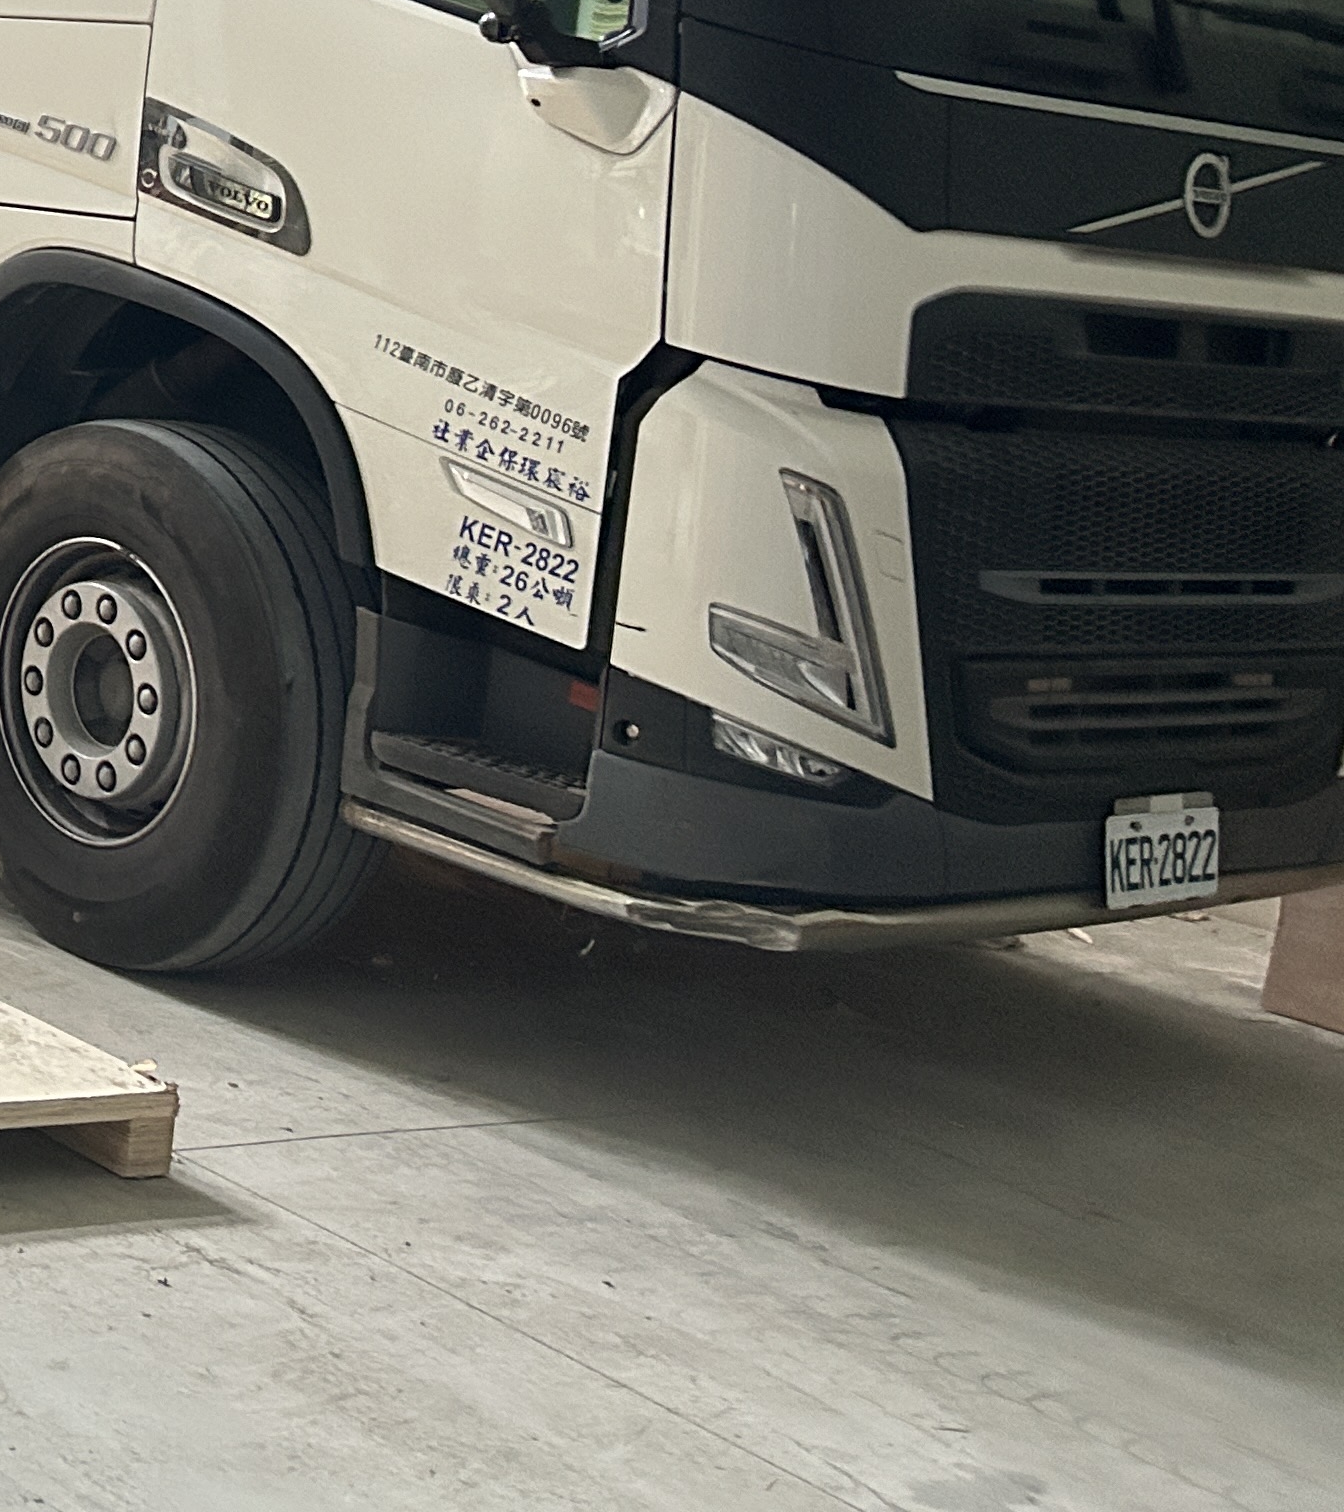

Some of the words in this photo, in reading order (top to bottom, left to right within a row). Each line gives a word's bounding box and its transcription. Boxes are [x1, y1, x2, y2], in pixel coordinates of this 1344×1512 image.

[34, 114, 117, 162] 500
[208, 180, 270, 212] VOLVO
[443, 397, 565, 455] 06-262-2211
[458, 514, 580, 584] KER-2822
[1109, 828, 1217, 894] KER-2822
